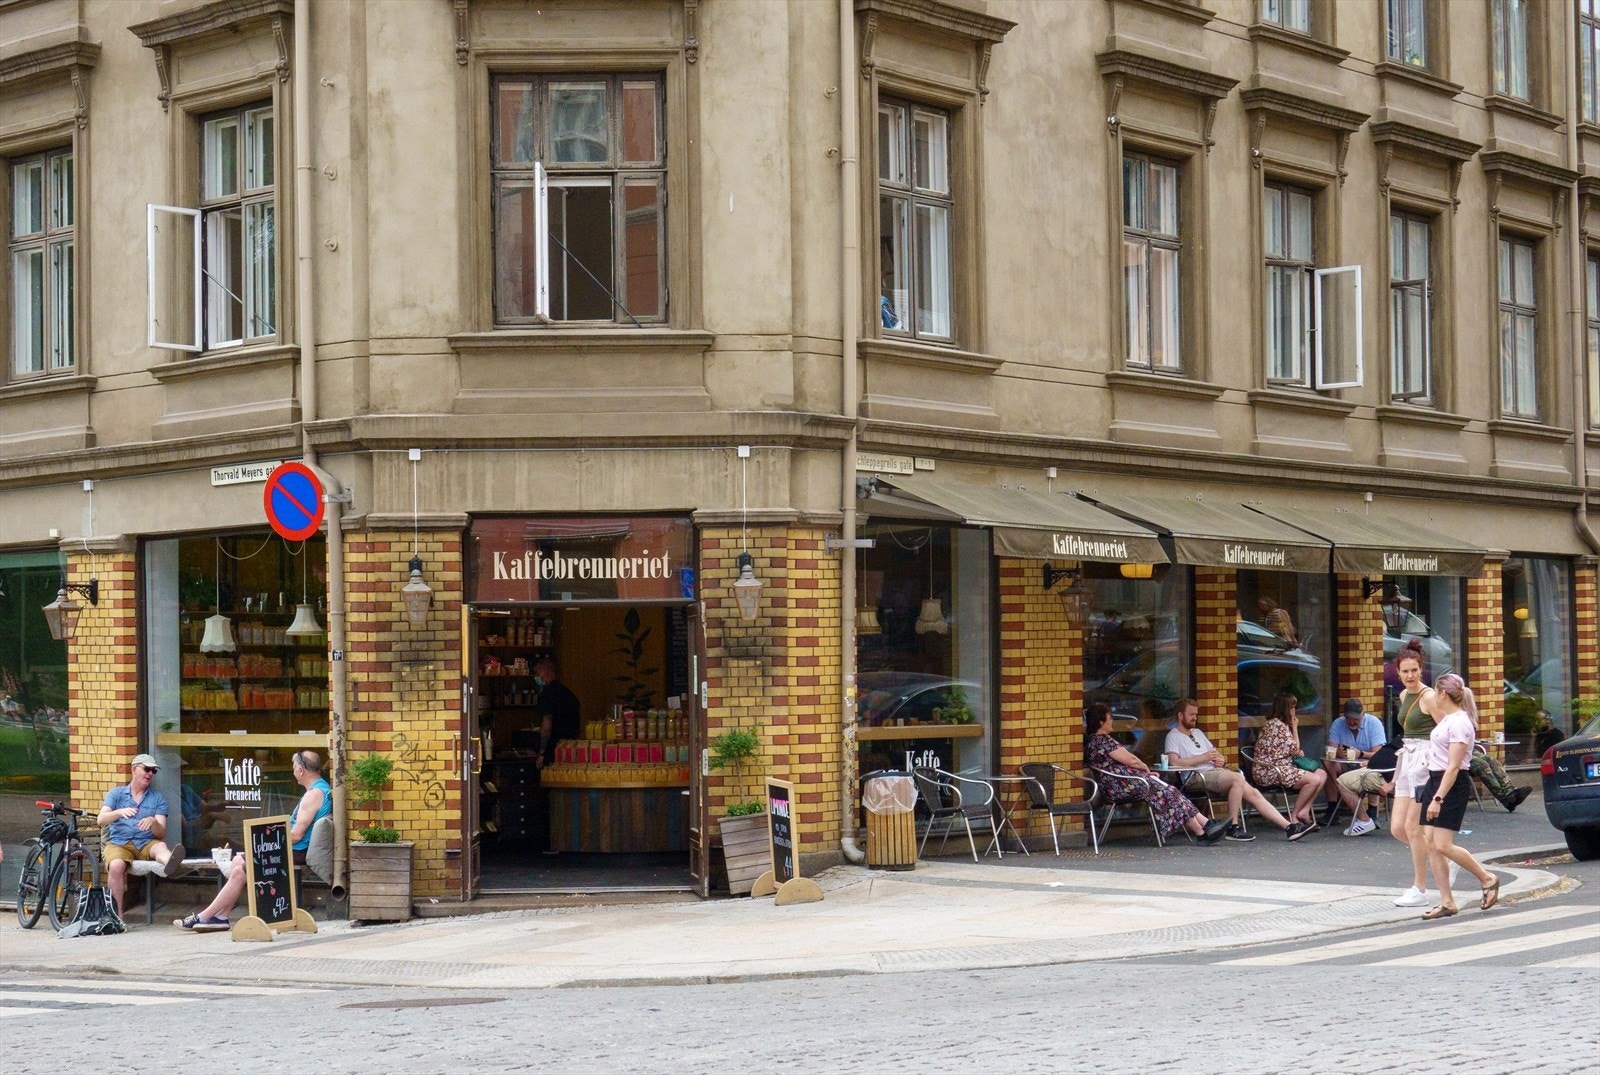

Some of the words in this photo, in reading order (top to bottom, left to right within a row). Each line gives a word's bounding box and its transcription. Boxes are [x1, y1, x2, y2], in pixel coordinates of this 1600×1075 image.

[857, 455, 897, 469] chleppegrells
[900, 461, 912, 472] gate
[214, 469, 239, 481] Thorvald
[241, 468, 264, 480] Meyers
[1053, 534, 1128, 558] Kaffebrenneriet
[1224, 544, 1285, 566] Kaffebrenneriet
[493, 550, 672, 580] Kaffebrenneriet
[1383, 553, 1438, 571] Kaffebrenneriet
[224, 758, 261, 786] Kaffe
[225, 787, 261, 801] brenneriet
